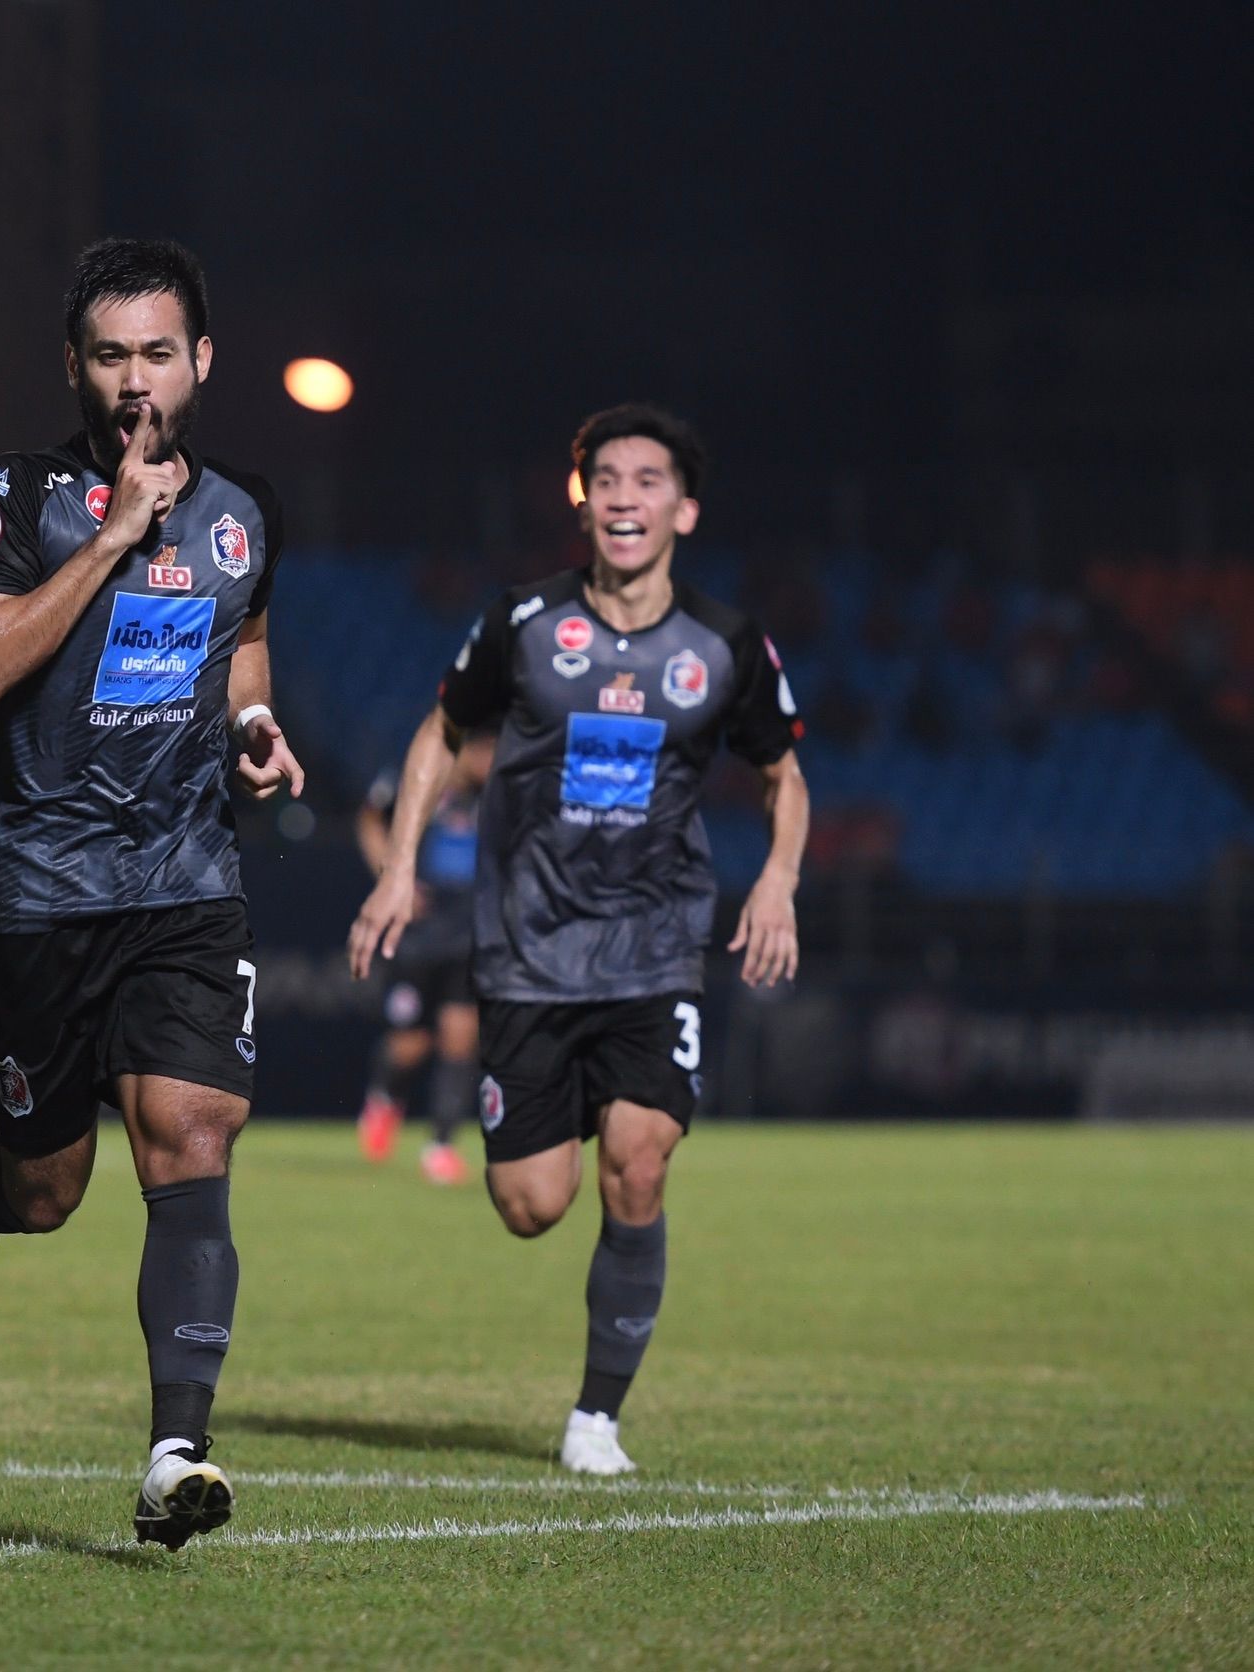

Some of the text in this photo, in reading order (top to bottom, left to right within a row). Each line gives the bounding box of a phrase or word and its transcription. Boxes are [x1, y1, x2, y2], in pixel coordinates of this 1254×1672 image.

[150, 567, 189, 587] LEO
[604, 690, 639, 707] LEO
[236, 959, 256, 1036] 7
[672, 1001, 701, 1070] 3
